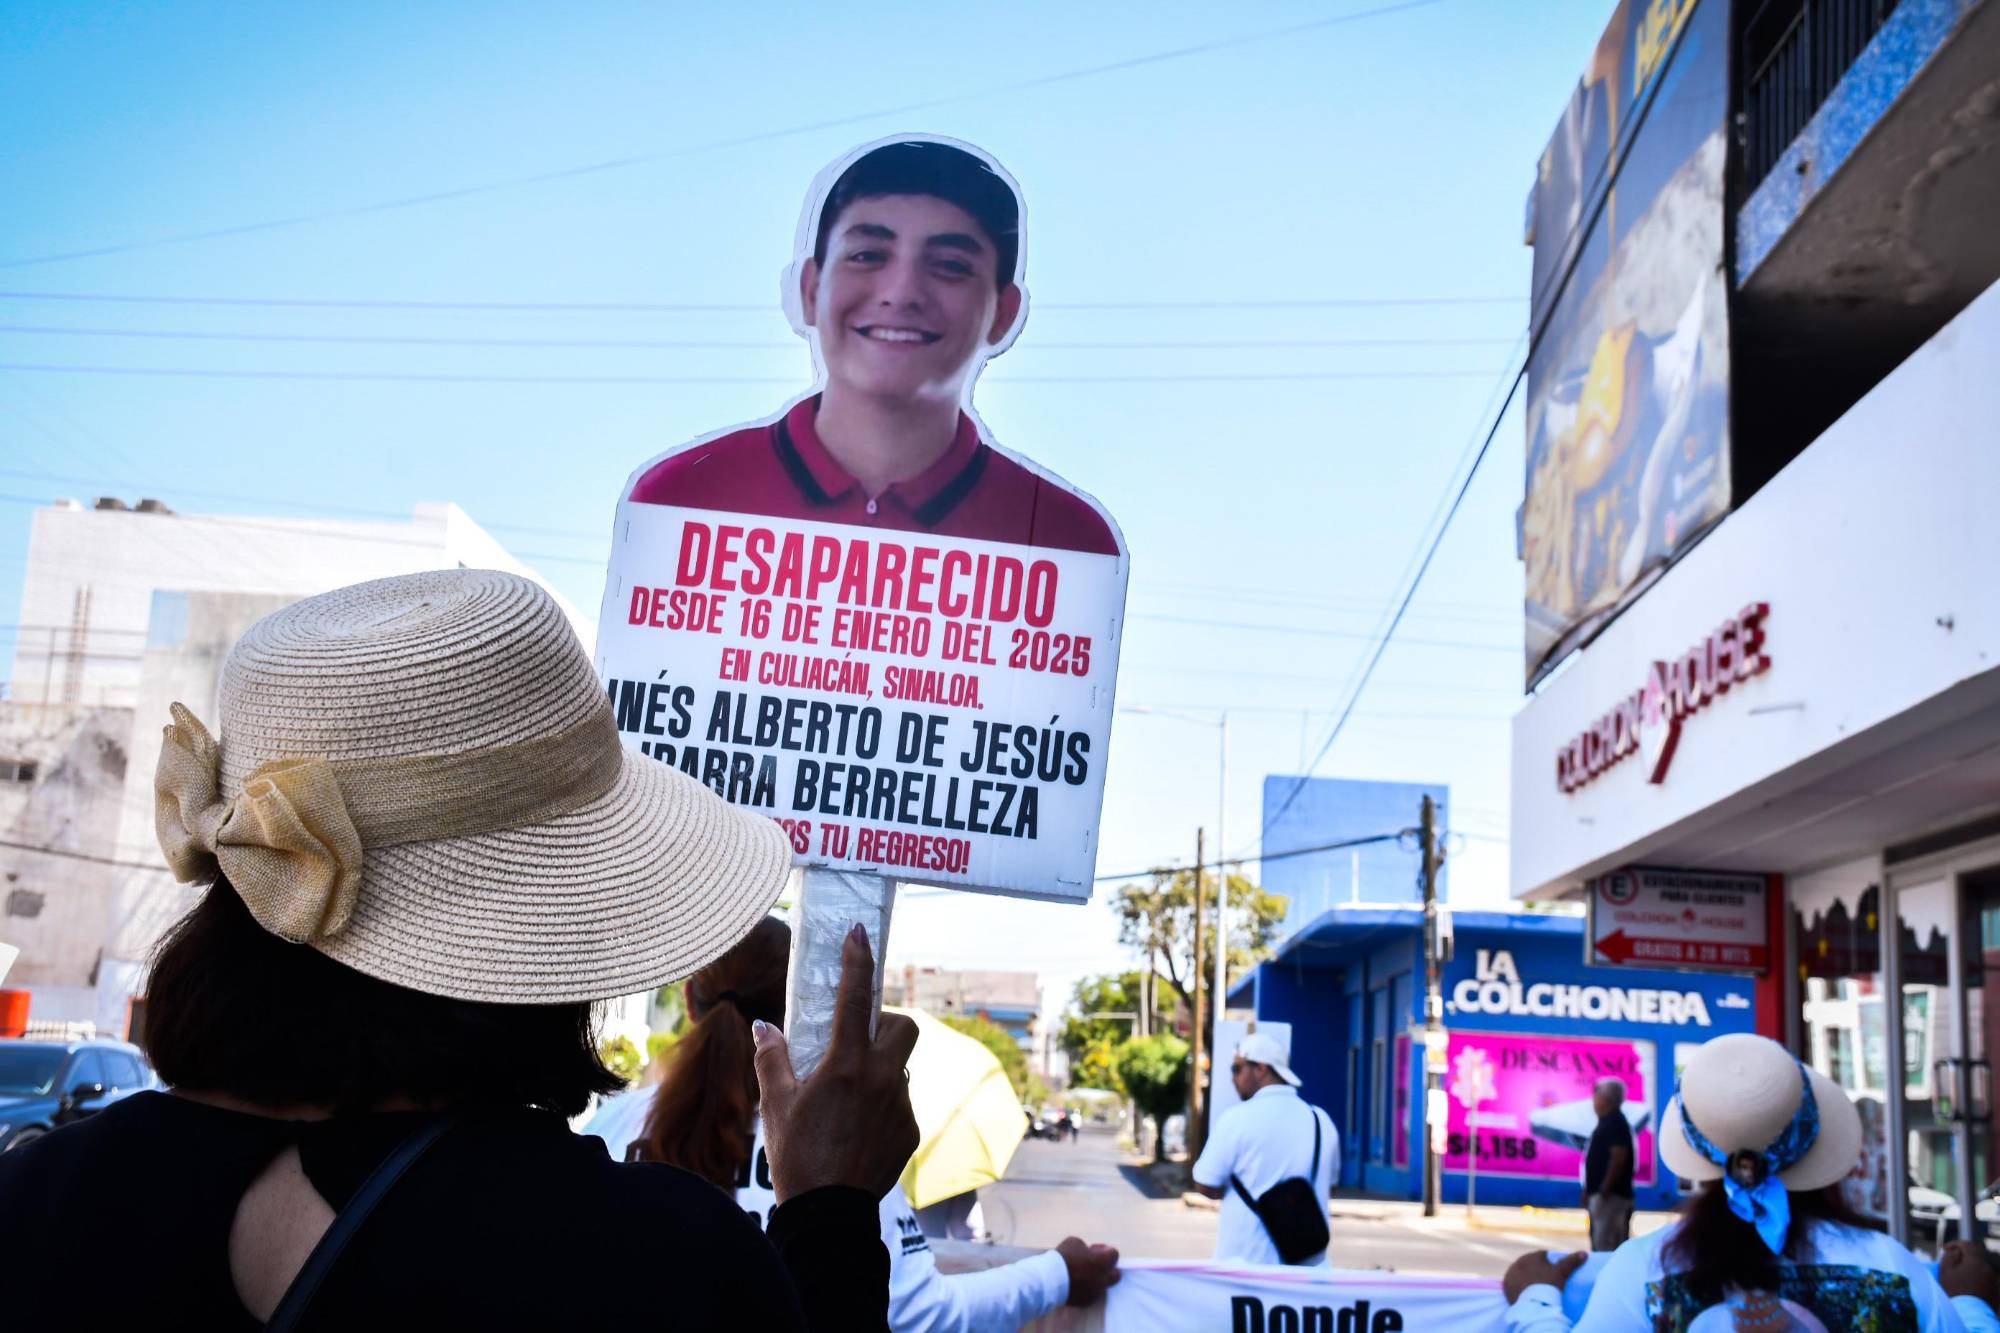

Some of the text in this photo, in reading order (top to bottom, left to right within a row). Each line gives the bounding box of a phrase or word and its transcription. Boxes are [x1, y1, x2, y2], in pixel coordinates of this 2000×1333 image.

[675, 521, 1058, 628] DESAPARECIDO
[628, 586, 1092, 677] DESDE 16 DE ENERO DEL 2025
[719, 648, 984, 710] EN CULIACÁN, SINALOA.
[1667, 602, 1771, 722] HOUSE
[608, 669, 1091, 786] INÉS ALBERTO DE JESÚS
[792, 760, 1039, 840] BERRELLEZA
[820, 822, 850, 860] TU
[855, 831, 971, 875] REGRESO!
[1610, 874, 1627, 897] E
[1476, 950, 1520, 983] LA
[1633, 941, 1682, 959] GRATIS
[1686, 945, 1697, 959] A
[1453, 979, 1711, 1026] COLCHONERA
[1231, 1296, 1403, 1333] Donde
